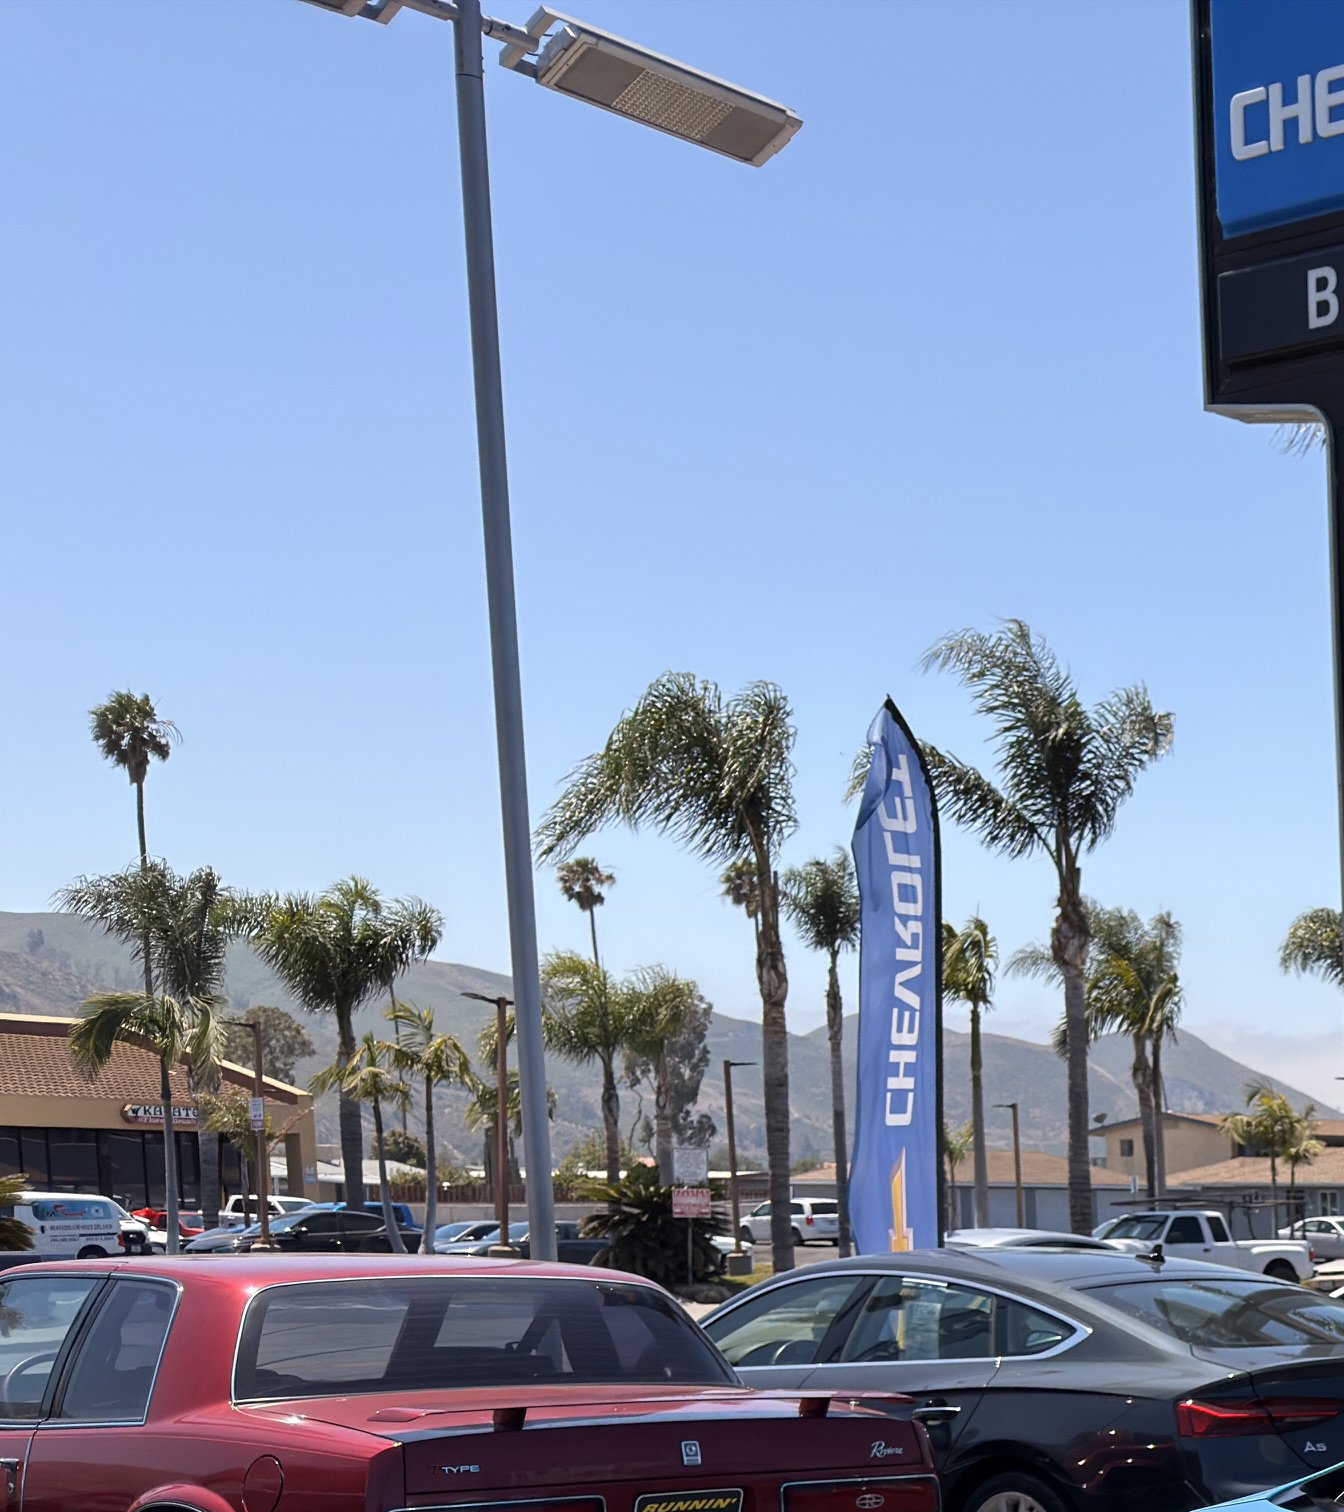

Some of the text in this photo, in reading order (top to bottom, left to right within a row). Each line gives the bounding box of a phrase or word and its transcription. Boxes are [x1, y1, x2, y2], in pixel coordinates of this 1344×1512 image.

[143, 1105, 197, 1118] KAATE
[1303, 1440, 1327, 1453] A5
[441, 1465, 480, 1474] TYPE
